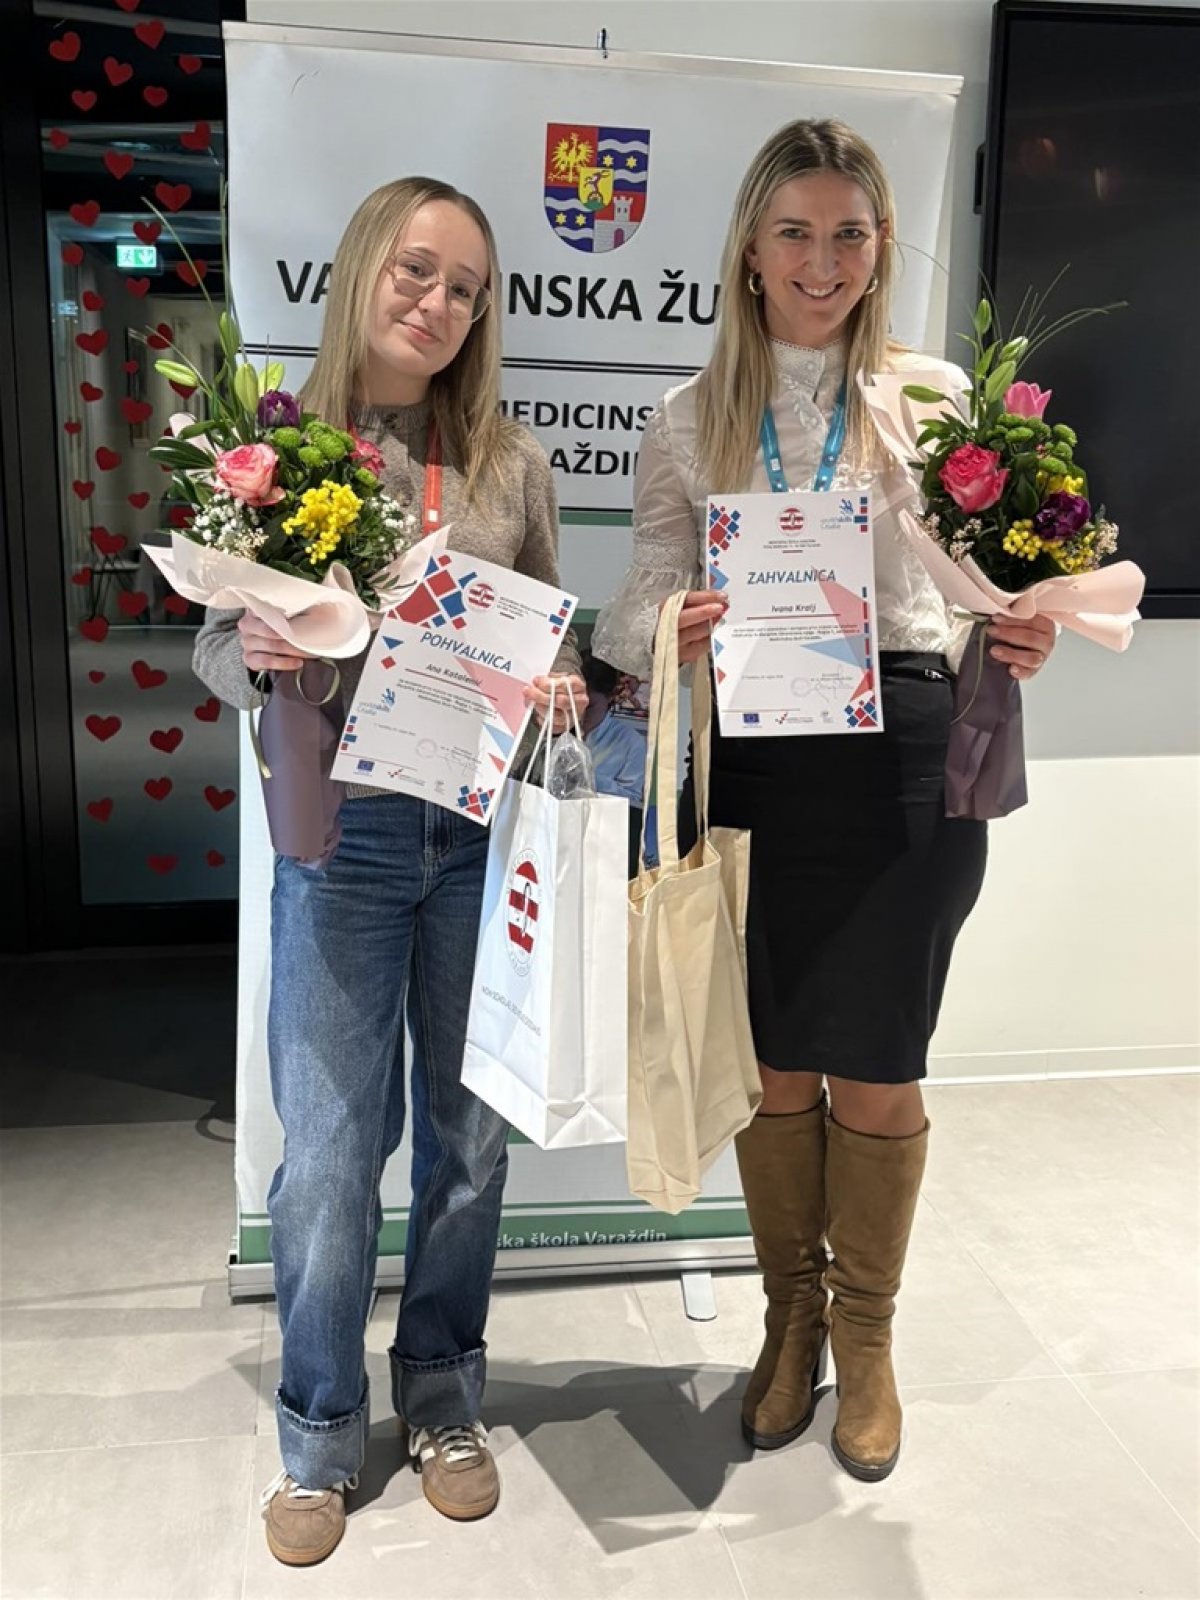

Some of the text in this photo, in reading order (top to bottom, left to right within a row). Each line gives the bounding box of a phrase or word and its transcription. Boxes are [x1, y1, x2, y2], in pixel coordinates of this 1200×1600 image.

[747, 568, 837, 585] ZAHVALNICA
[420, 631, 512, 672] POHVALNICA
[530, 1231, 579, 1247] škola
[583, 1229, 667, 1245] Varaždin
